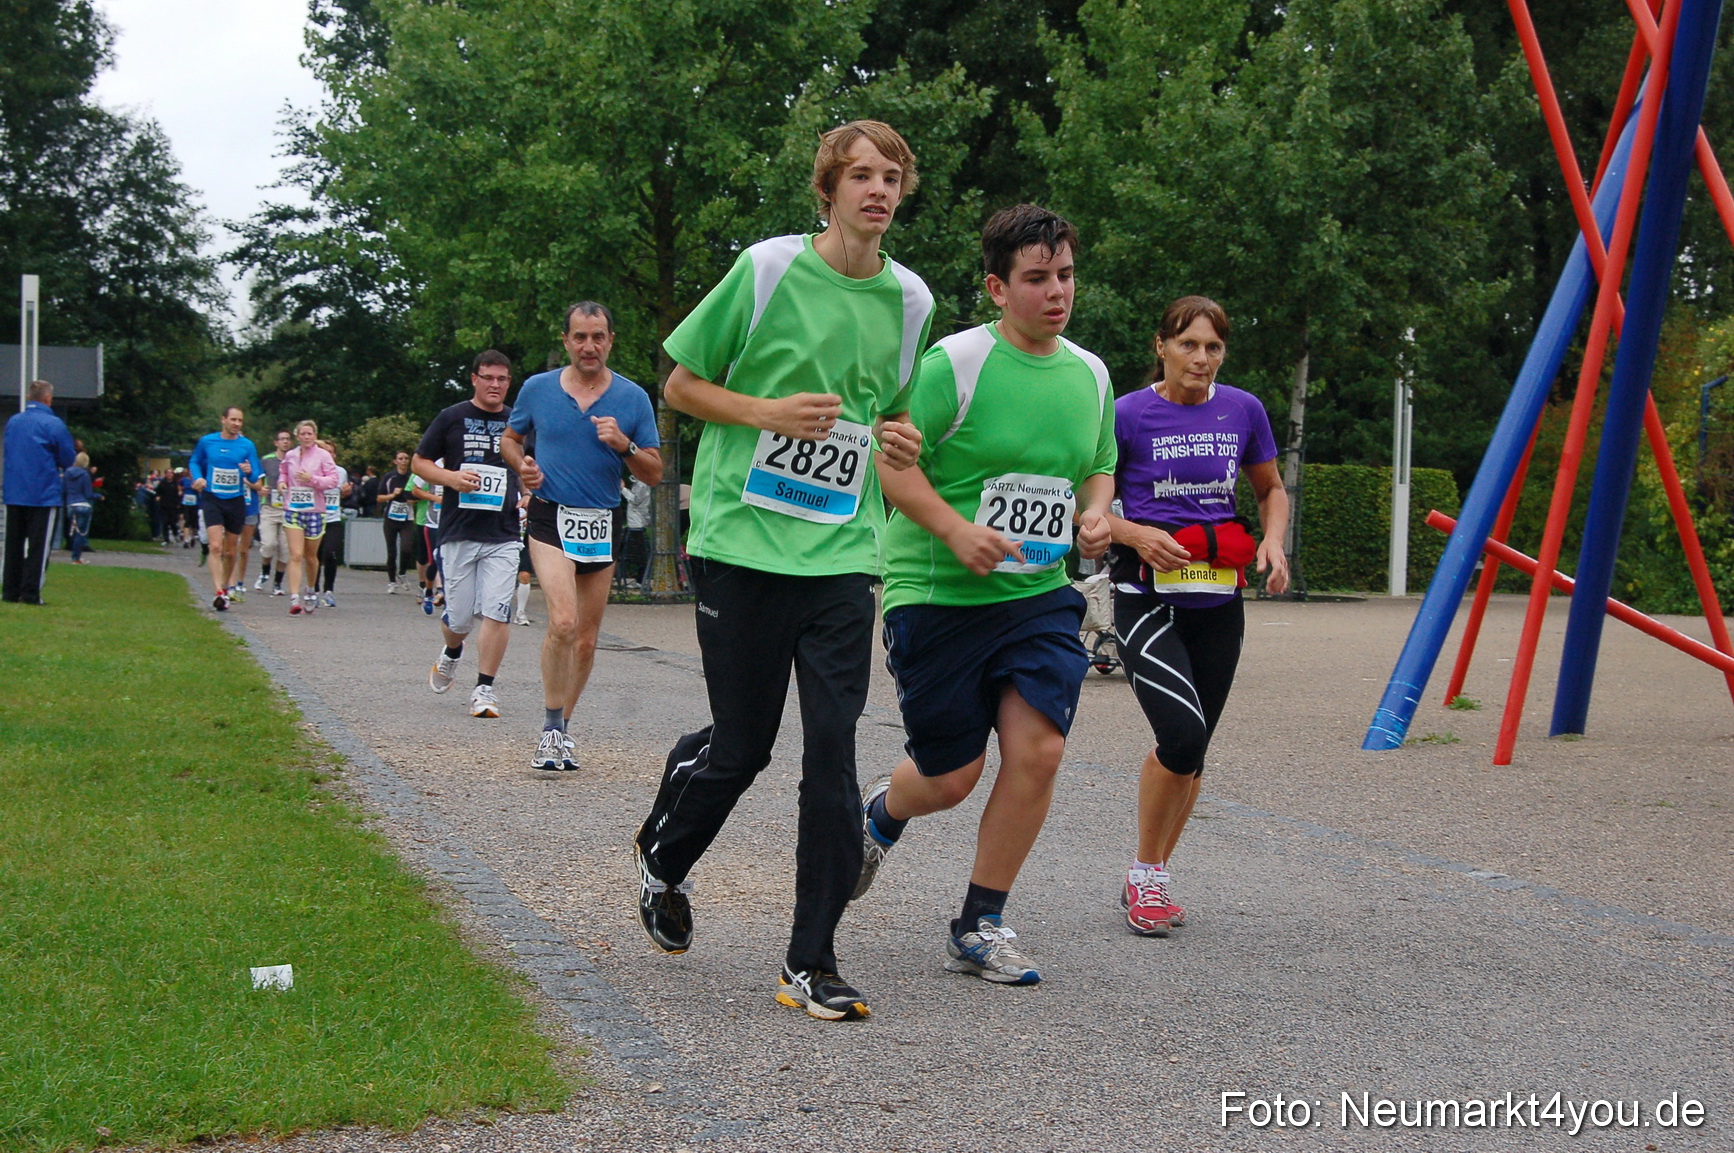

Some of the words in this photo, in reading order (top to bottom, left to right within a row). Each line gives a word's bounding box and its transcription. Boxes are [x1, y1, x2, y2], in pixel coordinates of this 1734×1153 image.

[829, 431, 858, 444] markt
[1152, 434, 1186, 447] ZURICH
[1188, 432, 1214, 443] GOES
[765, 431, 859, 487] 2829
[1153, 443, 1215, 461] FINISHER
[1217, 443, 1238, 457] 2012
[774, 481, 830, 508] Samuel
[986, 482, 1016, 492] ARTL
[1017, 483, 1061, 497] Neumarkt
[986, 496, 1066, 539] 2828
[564, 518, 608, 540] 2566
[1180, 568, 1218, 580] Renate
[698, 601, 719, 618] Samuel
